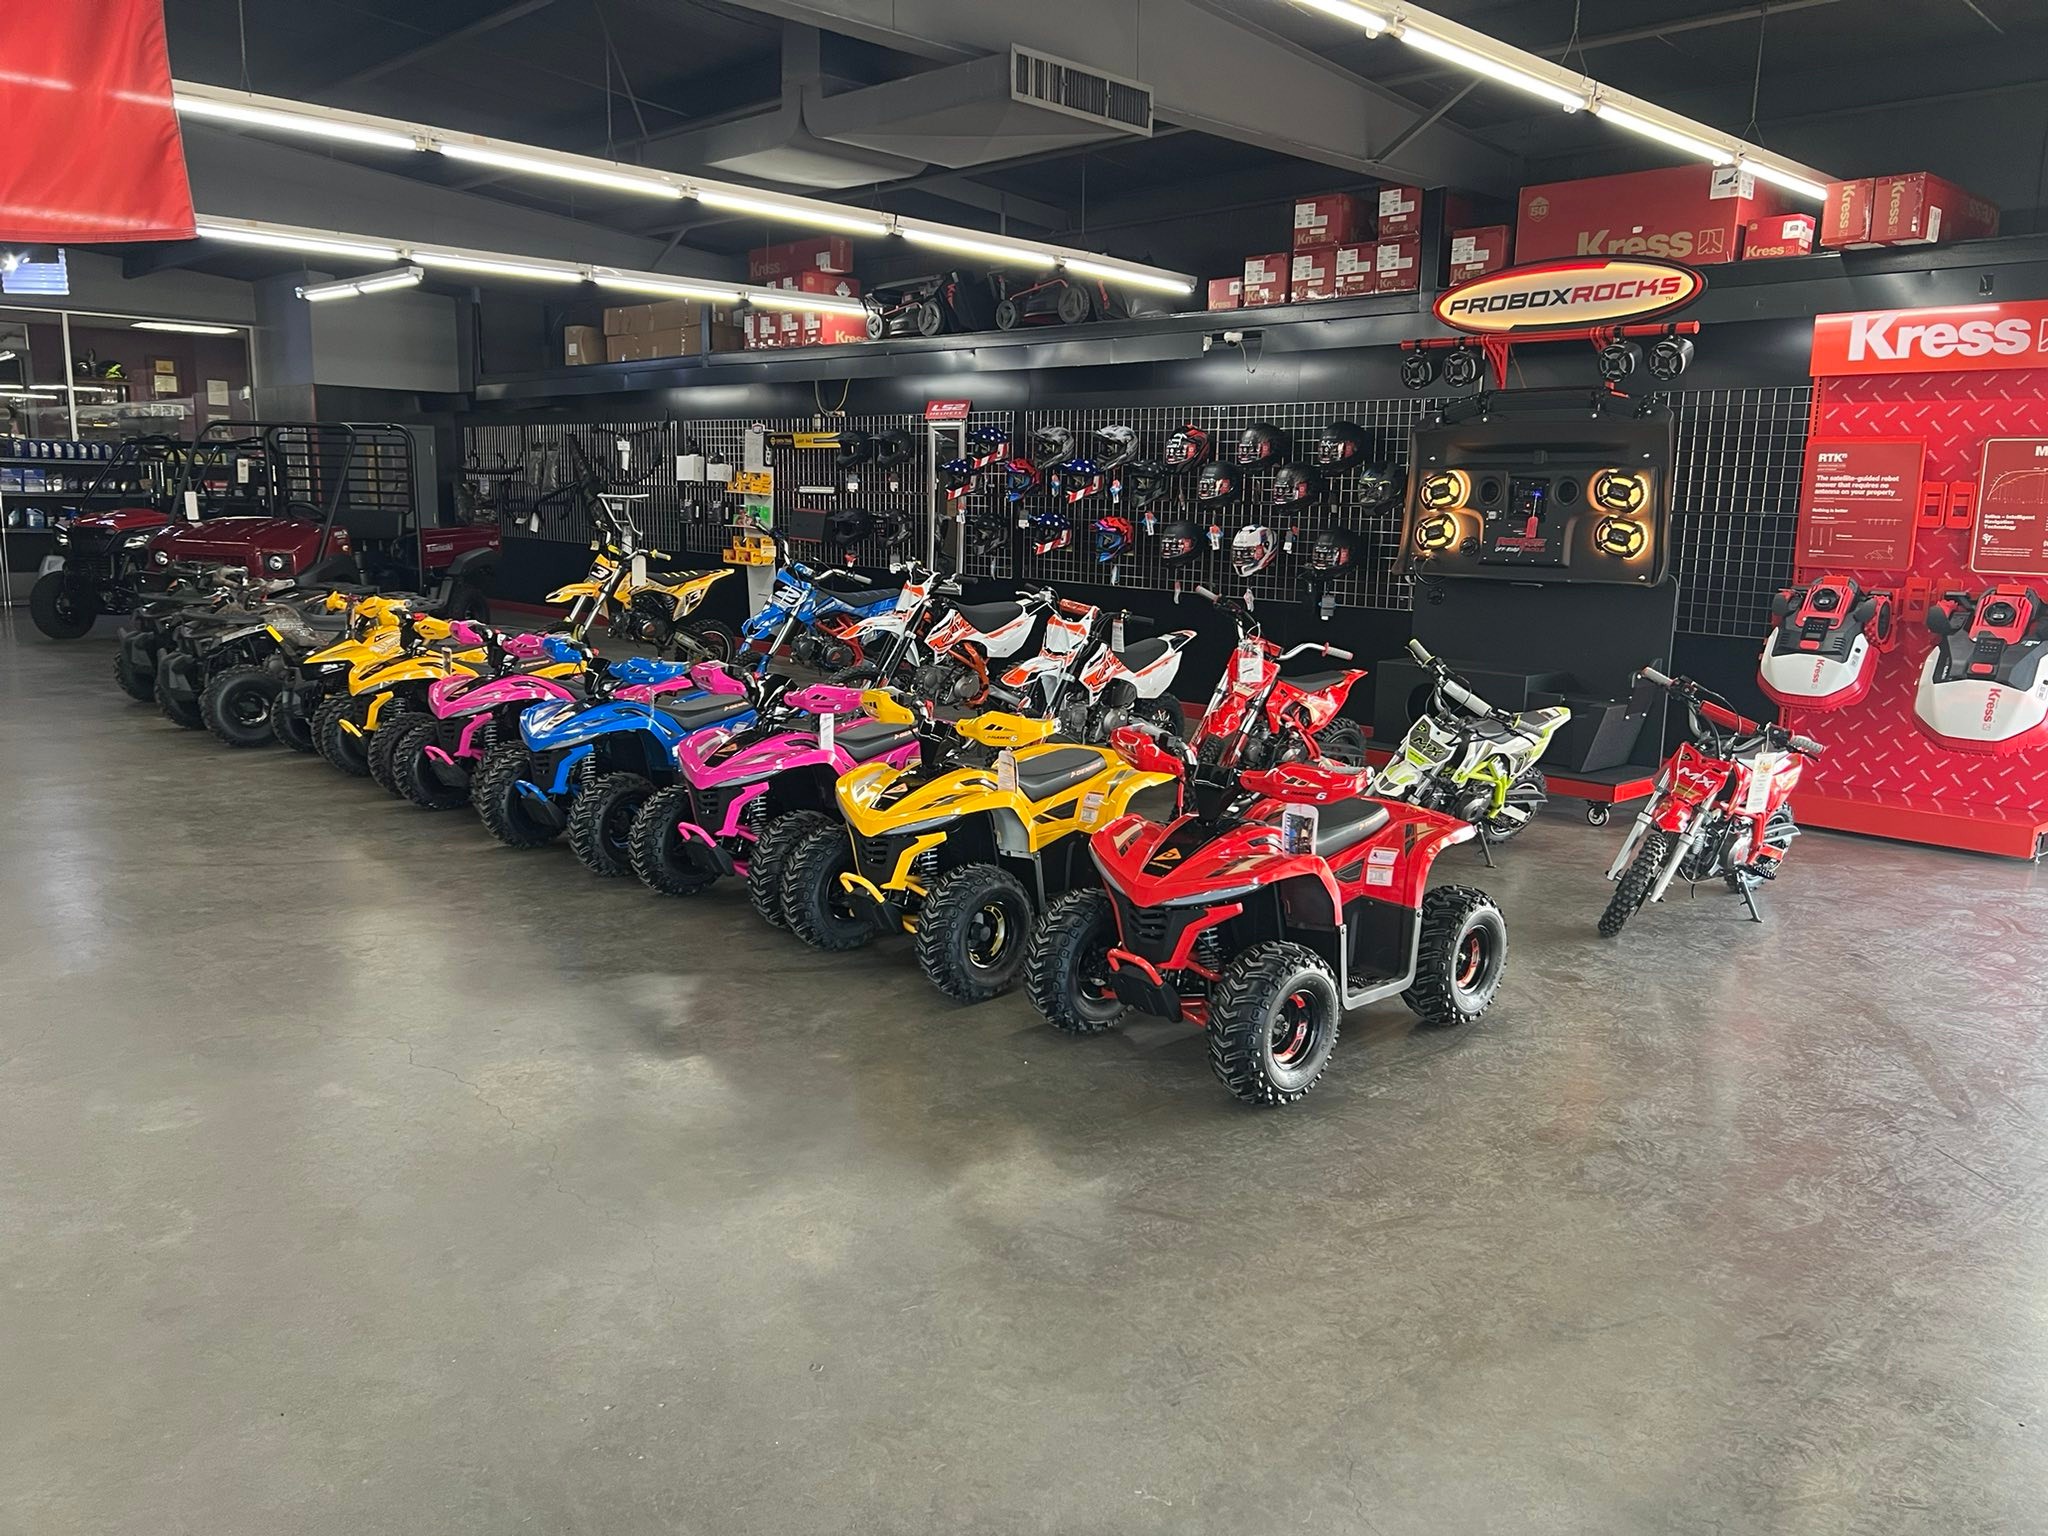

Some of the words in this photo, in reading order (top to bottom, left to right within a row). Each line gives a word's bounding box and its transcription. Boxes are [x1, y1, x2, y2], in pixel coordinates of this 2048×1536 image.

[1840, 184, 1856, 229] Kress
[1888, 180, 1906, 226] Kress
[1577, 229, 1694, 258] Kress
[1746, 245, 1785, 258] Kress
[1449, 276, 1682, 316] PROBOXROCKS
[1848, 312, 2032, 361] Kress
[931, 403, 966, 412] LS2
[1830, 475, 1880, 483] satellite-guided
[1866, 489, 1896, 497] property
[591, 566, 610, 579] 3
[1812, 658, 1825, 684] Kress
[1983, 687, 2002, 723] Kress
